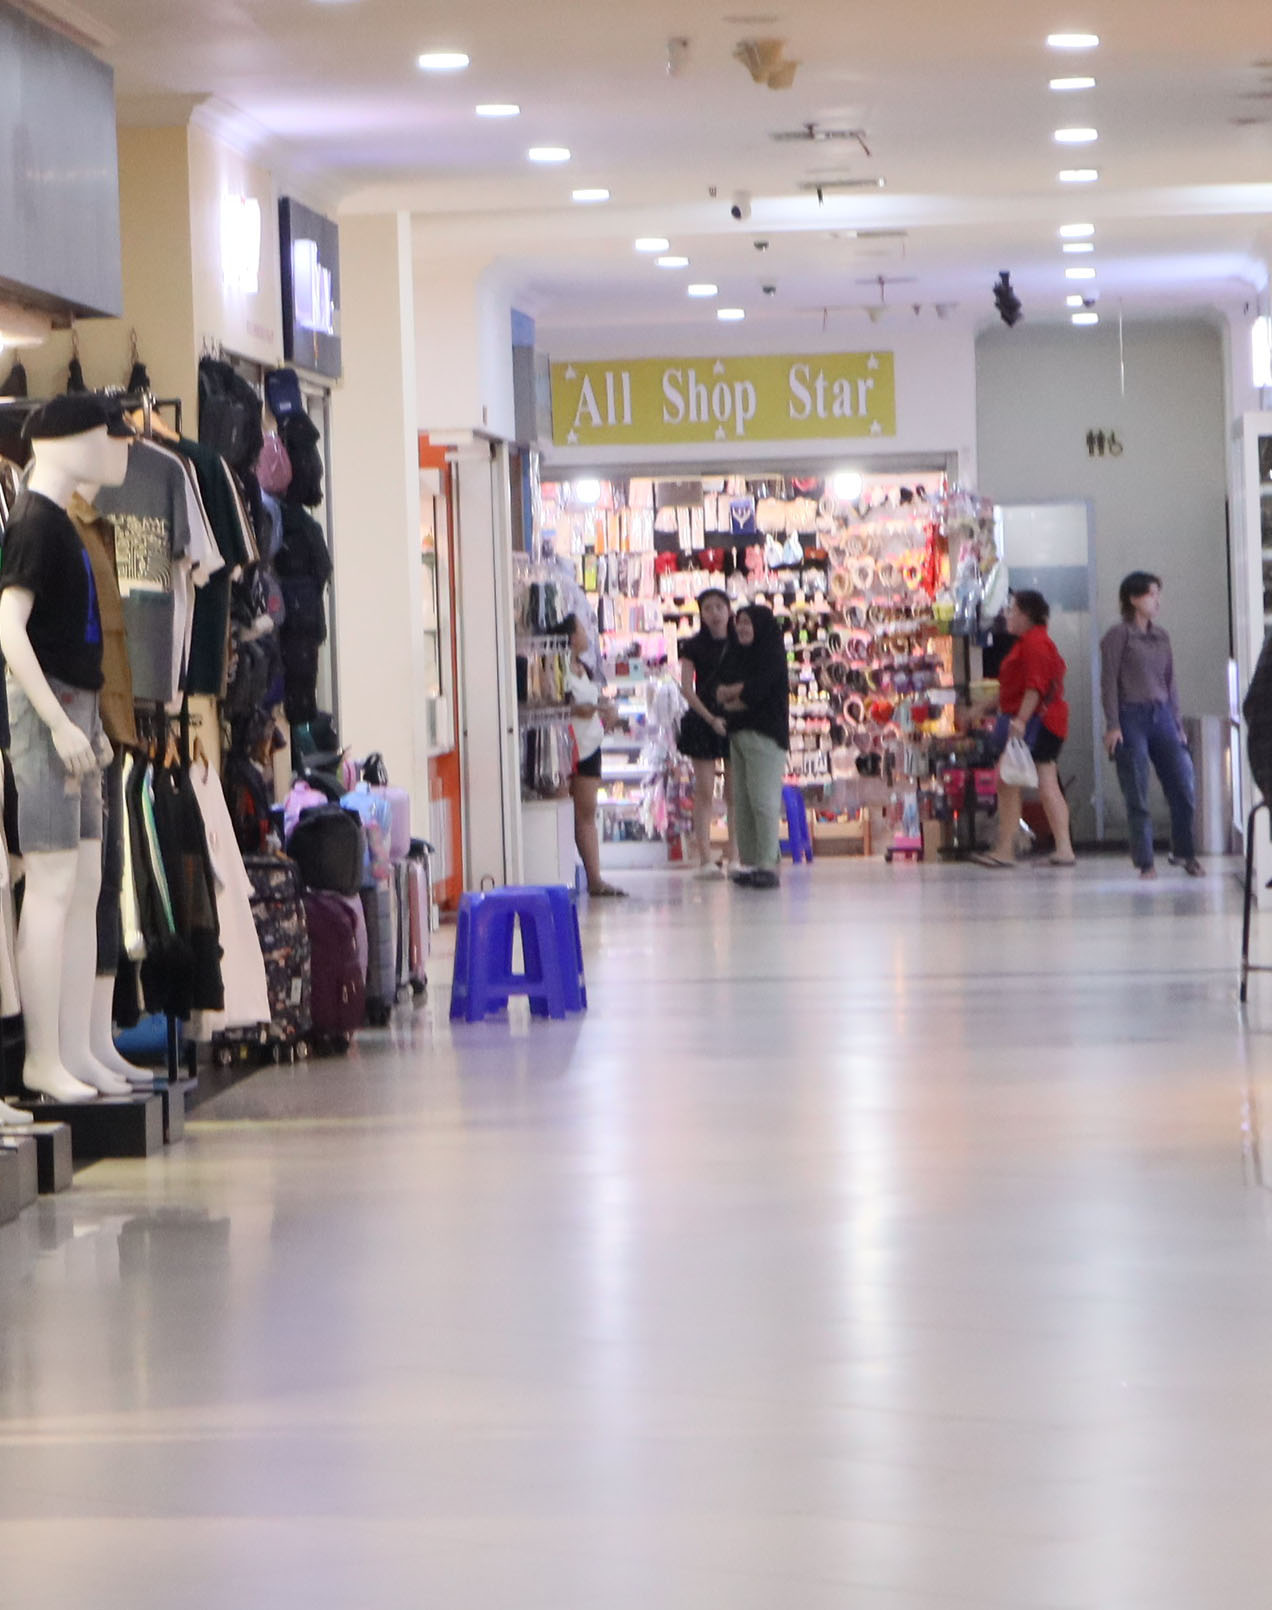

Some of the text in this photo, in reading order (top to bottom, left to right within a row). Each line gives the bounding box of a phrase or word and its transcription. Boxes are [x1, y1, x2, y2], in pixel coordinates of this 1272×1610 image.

[574, 363, 875, 436] All Shop Star
